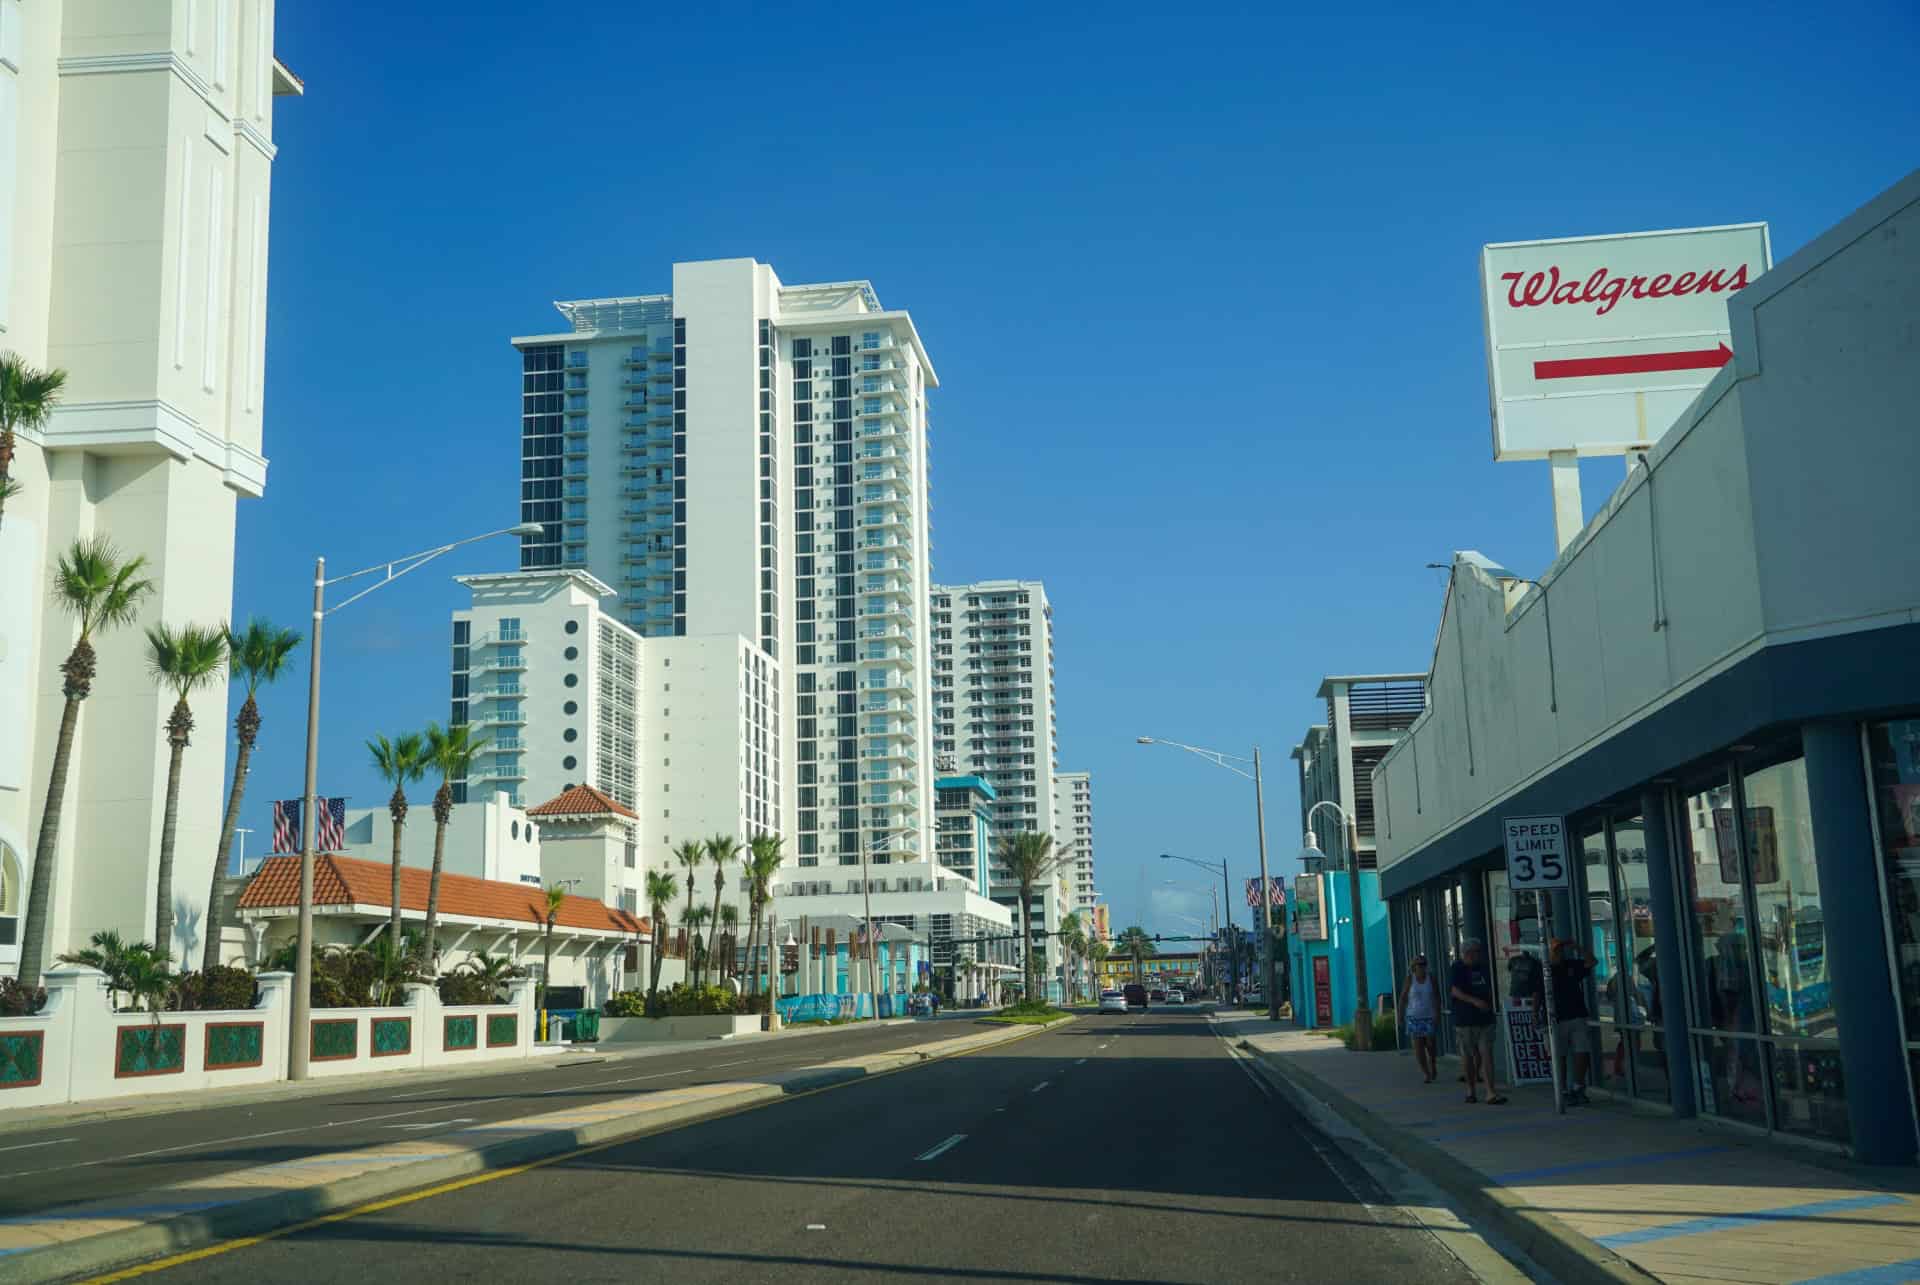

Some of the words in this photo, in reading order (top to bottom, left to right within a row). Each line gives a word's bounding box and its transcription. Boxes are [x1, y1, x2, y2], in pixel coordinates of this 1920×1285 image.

[1502, 264, 1750, 315] Walgreens
[1509, 823, 1560, 837] SPEED
[1515, 838, 1555, 852] LIMIT
[1514, 854, 1563, 882] 35
[1512, 1025, 1544, 1041] BUY
[1515, 1042, 1545, 1059] GET
